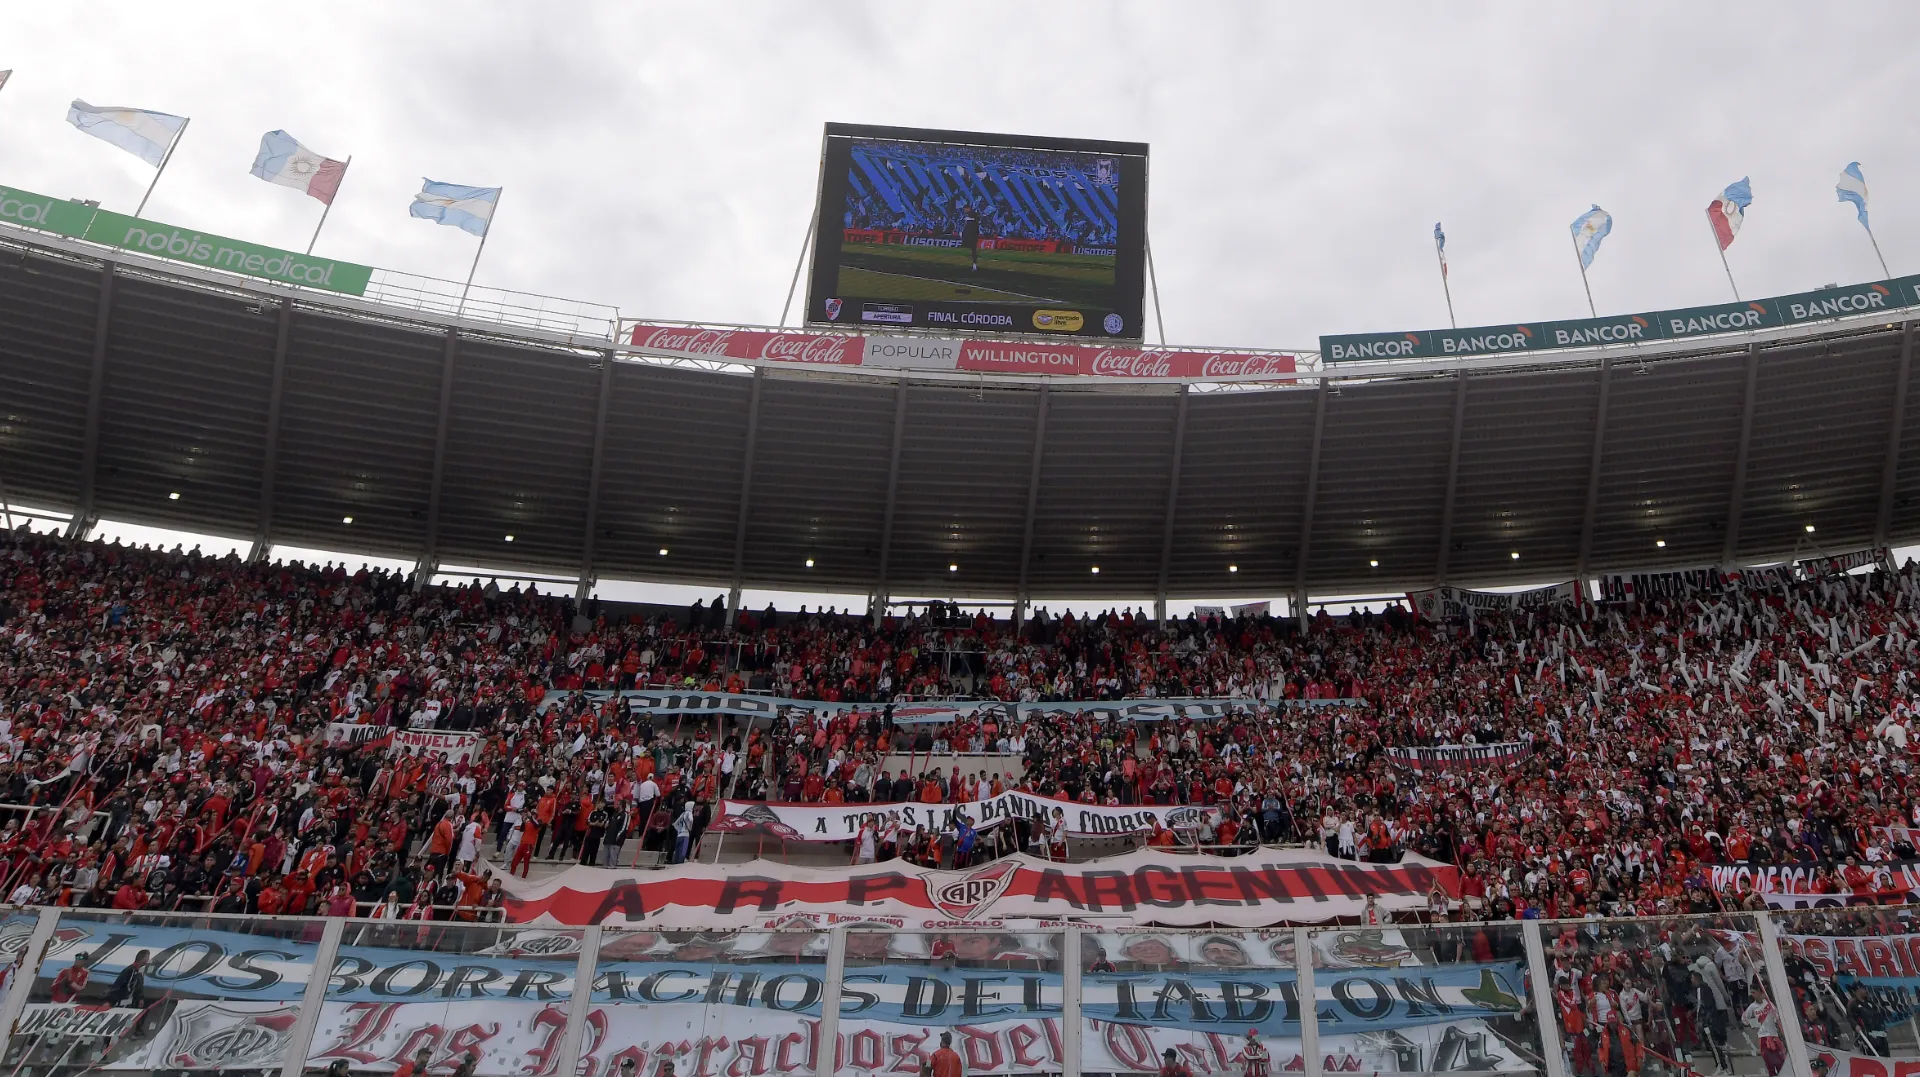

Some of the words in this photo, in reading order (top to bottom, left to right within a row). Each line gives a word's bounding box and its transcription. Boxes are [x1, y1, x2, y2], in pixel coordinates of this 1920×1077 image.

[122, 226, 212, 261] nobis
[213, 245, 336, 286] medical
[928, 311, 959, 323] FINAL
[961, 312, 1013, 325] CÓRDOBA
[1790, 291, 1886, 319] BANCOR
[1555, 322, 1643, 345] BANCOR
[1670, 310, 1762, 334] BANCOR
[762, 335, 851, 362] Coca-Cola
[871, 344, 952, 360] POPULAR
[1331, 340, 1415, 359] BANCOR
[1443, 332, 1528, 353] BANCOR
[966, 348, 1074, 366] WILLINGTON
[1092, 350, 1175, 376] Coca-Cola
[1801, 559, 1832, 579] LAS
[1834, 548, 1886, 571] TUNAS
[1441, 589, 1452, 600] SI
[1603, 575, 1627, 601] LA
[1632, 567, 1723, 600] MATANZA
[815, 817, 827, 833] A
[926, 804, 968, 833] LAS
[1033, 861, 1440, 913] ARGENTINA
[1756, 866, 1778, 893] DE
[867, 917, 904, 928] ALBINO
[922, 919, 1001, 928] GONZALO
[58, 933, 302, 992] LOS
[295, 955, 888, 1013] BORRACHOS
[901, 976, 1063, 1021] DEL
[1108, 974, 1457, 1023] TABLON
[309, 1002, 501, 1070] Los
[525, 1001, 932, 1077] Borrachos
[951, 1017, 1066, 1073] del
